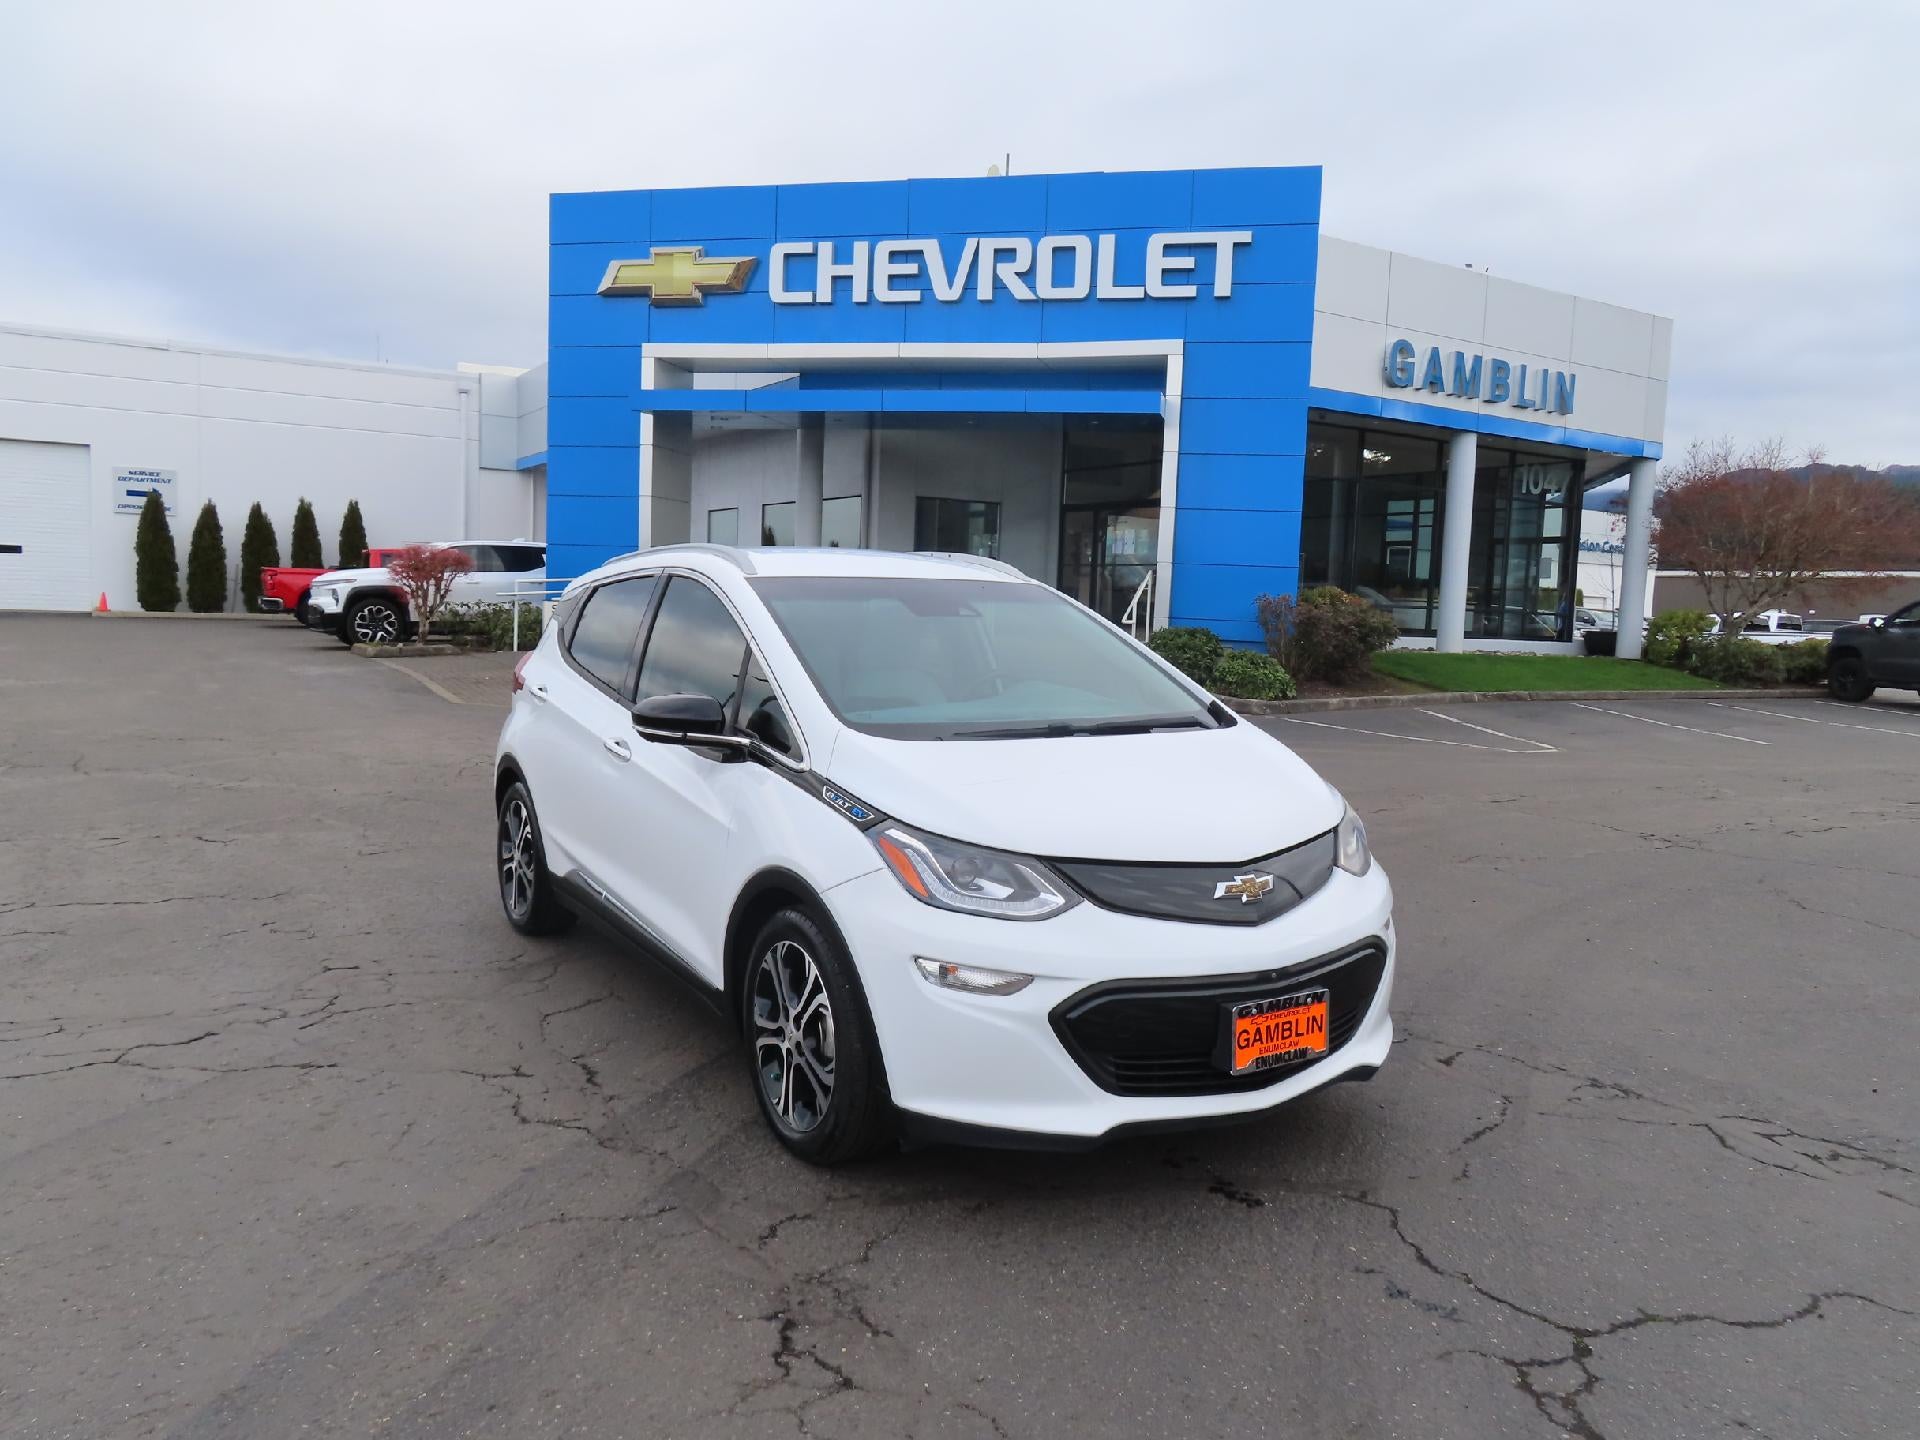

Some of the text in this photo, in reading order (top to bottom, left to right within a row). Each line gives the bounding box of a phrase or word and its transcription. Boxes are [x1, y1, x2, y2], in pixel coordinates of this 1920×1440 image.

[769, 230, 1252, 303] CHEVROLET
[1385, 339, 1576, 415] GAMBLIN
[117, 476, 172, 484] DEPARTMENT
[1238, 991, 1325, 1019] GAMBLIN
[1270, 1006, 1312, 1021] CHEVROLET
[1237, 1013, 1324, 1050] GAMBLIN
[1255, 1047, 1308, 1070] ENUMCLAW
[1259, 1039, 1300, 1055] ENUMCLAW
